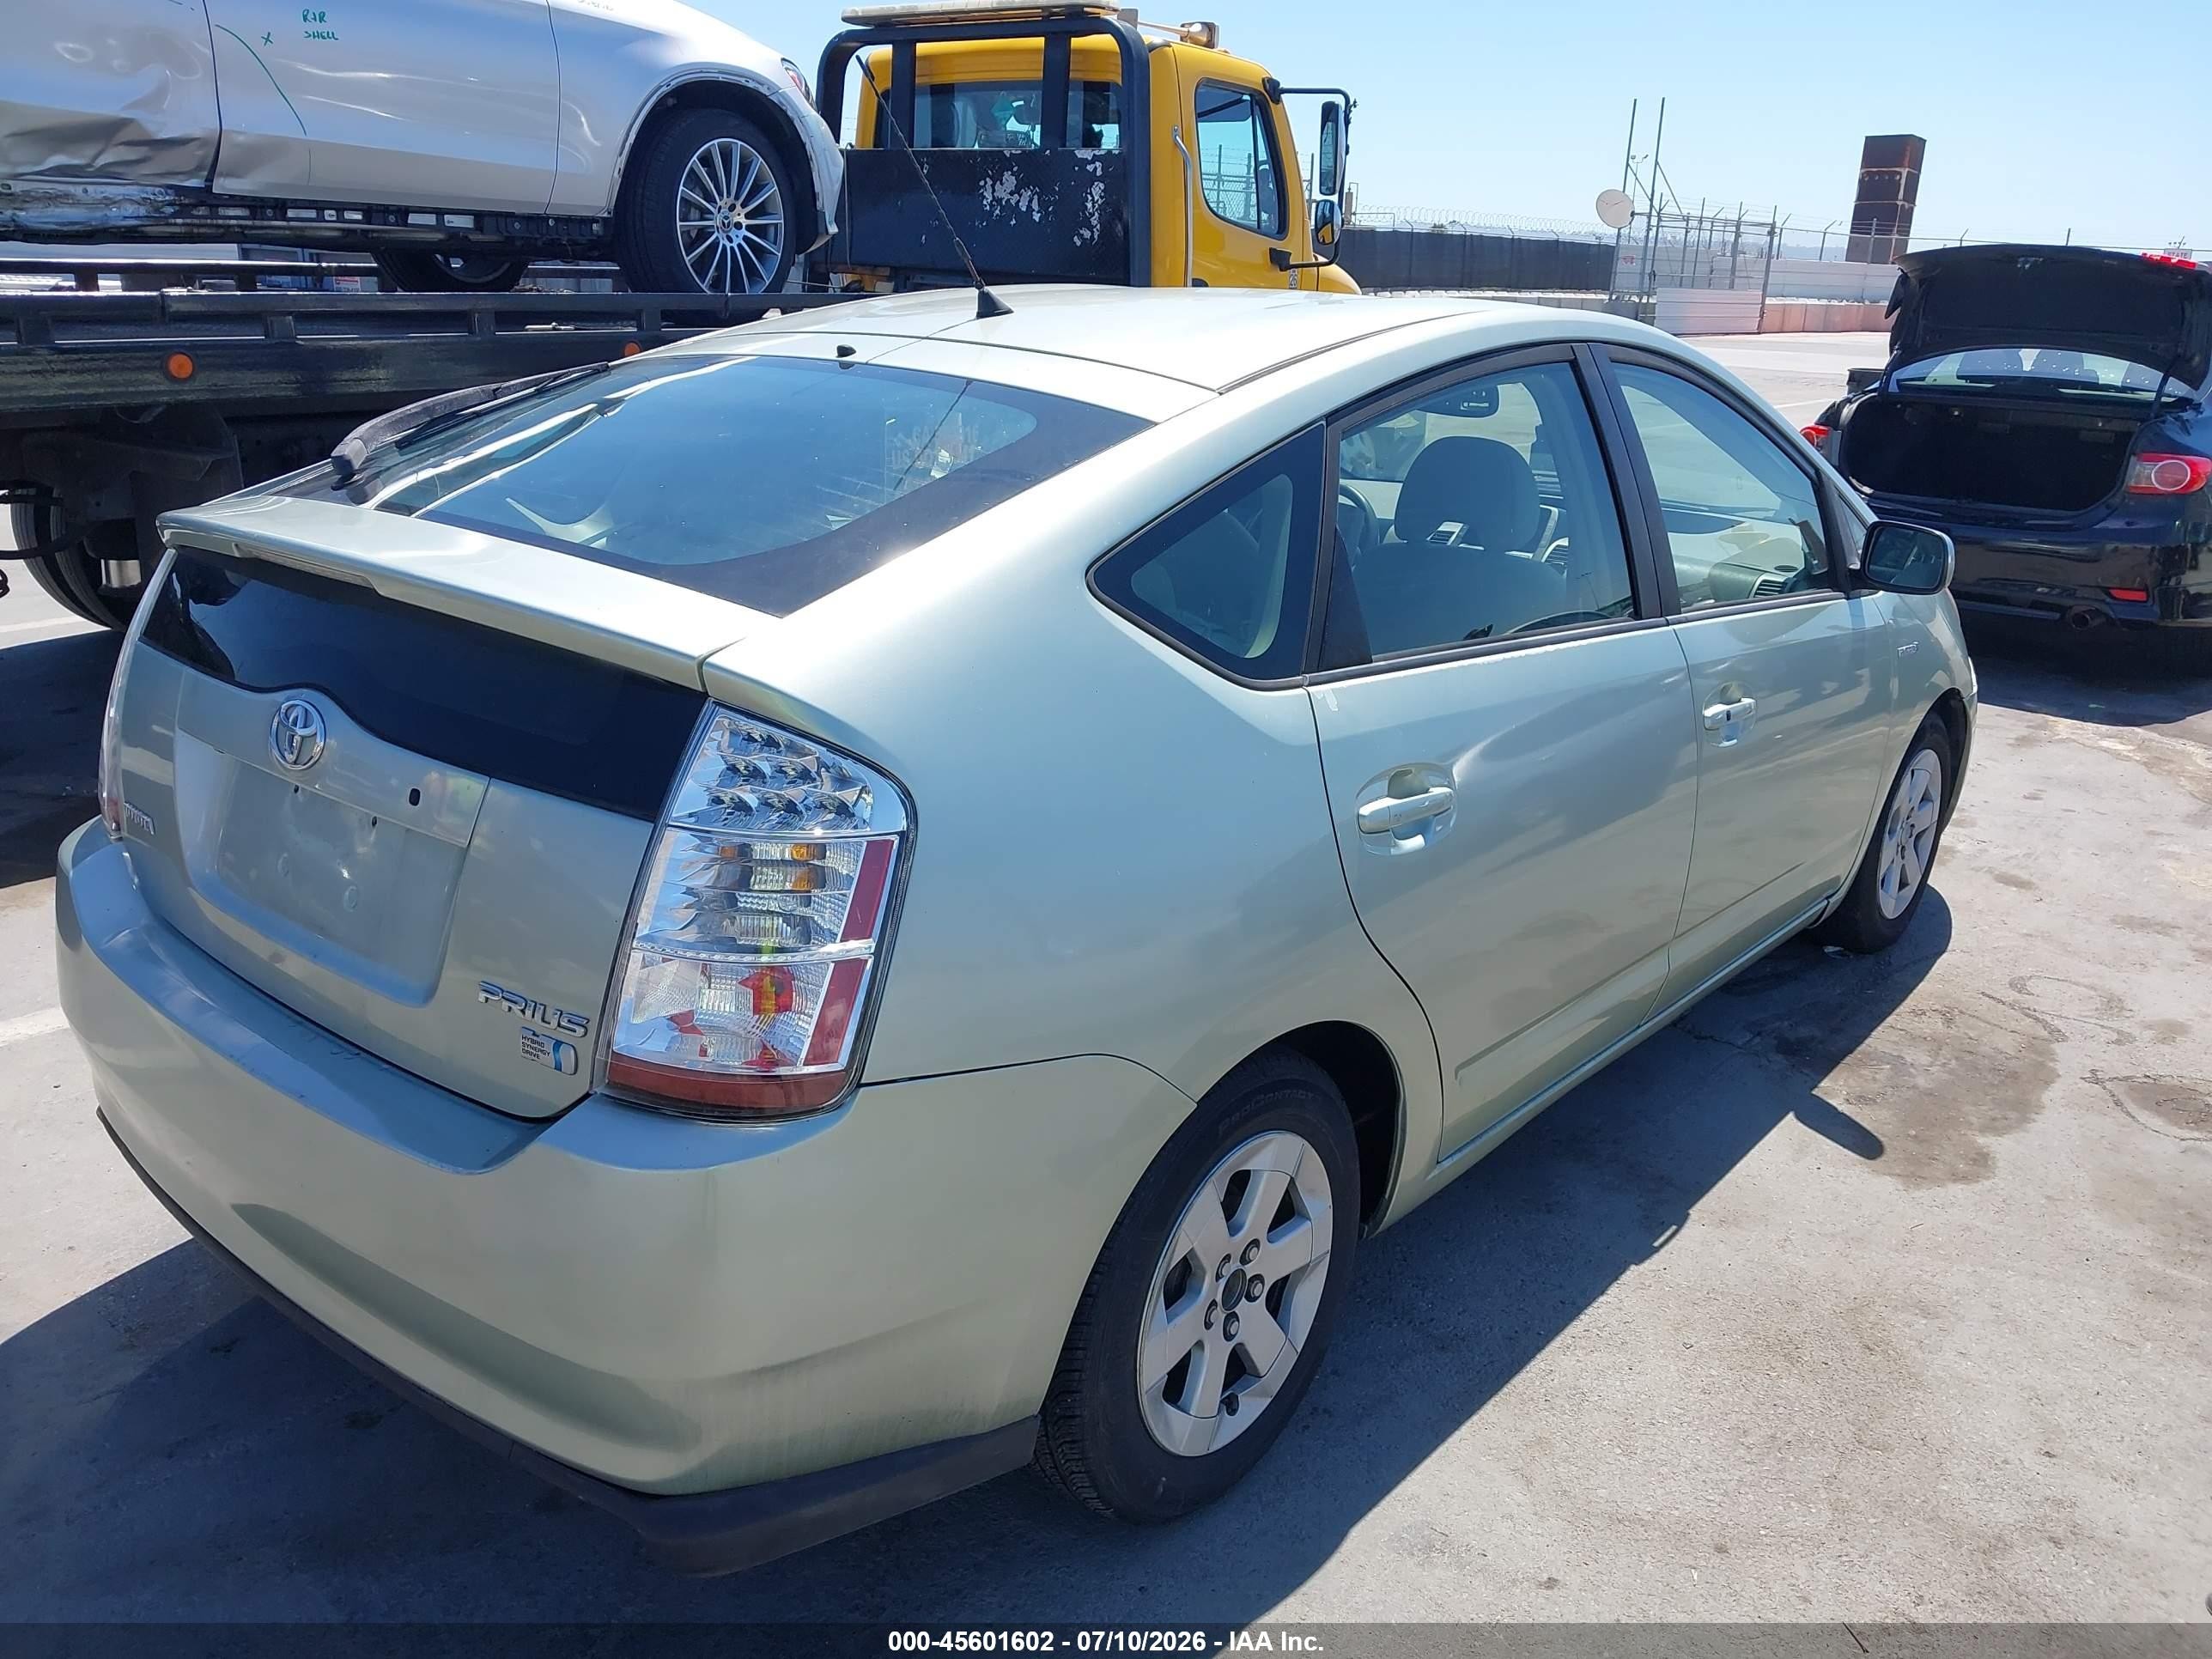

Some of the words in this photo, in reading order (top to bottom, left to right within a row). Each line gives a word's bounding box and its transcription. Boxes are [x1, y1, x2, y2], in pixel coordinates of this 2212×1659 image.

[303, 30, 339, 40] SHELL
[478, 981, 590, 1038] PRIUS
[521, 1035, 544, 1048] HYBRID
[521, 1042, 550, 1057] SYNERGY
[521, 1048, 540, 1060] DRIVE
